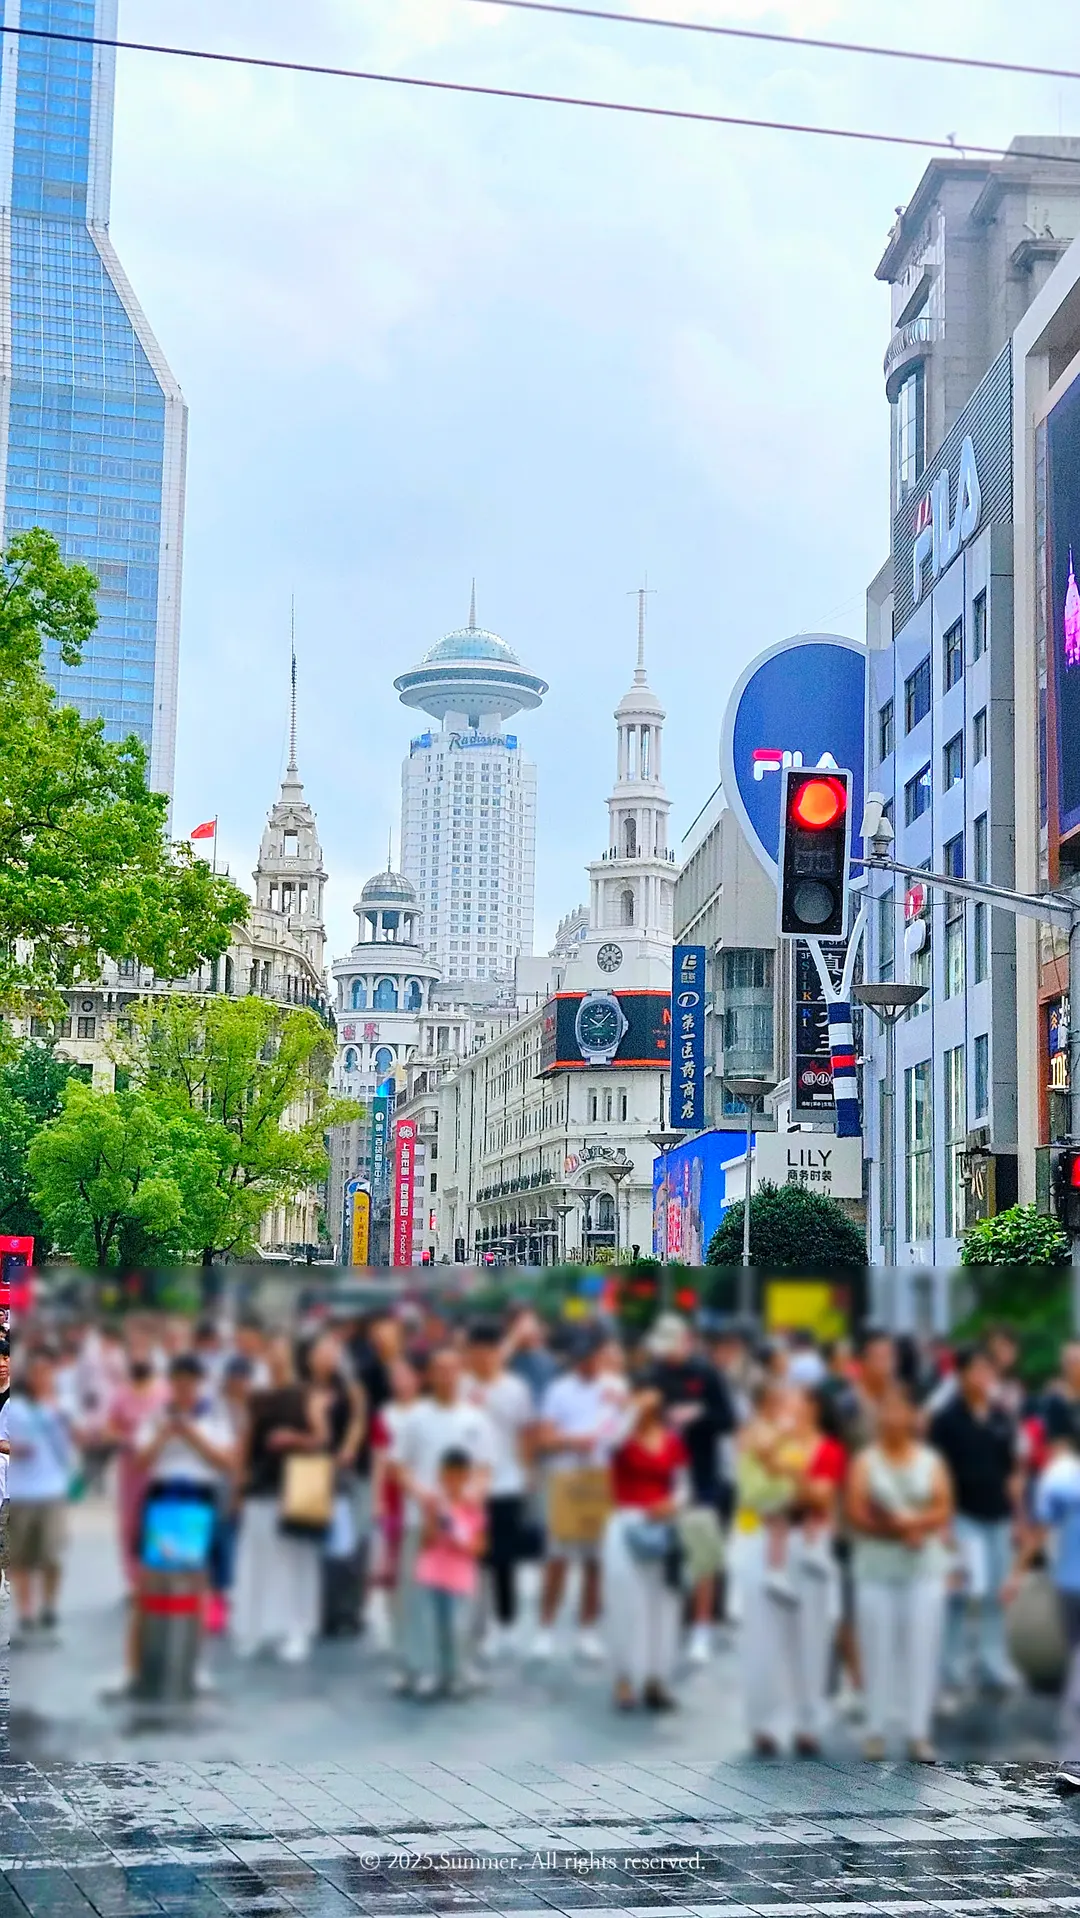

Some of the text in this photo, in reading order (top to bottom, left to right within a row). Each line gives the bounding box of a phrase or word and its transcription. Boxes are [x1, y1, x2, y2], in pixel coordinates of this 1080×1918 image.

[914, 435, 982, 604] FILA
[449, 730, 505, 751] Radisson
[340, 1022, 381, 1042] 世界
[680, 1013, 697, 1119] 第一医药商店
[787, 1149, 833, 1167] LILY
[787, 1169, 833, 1182] 商务时装
